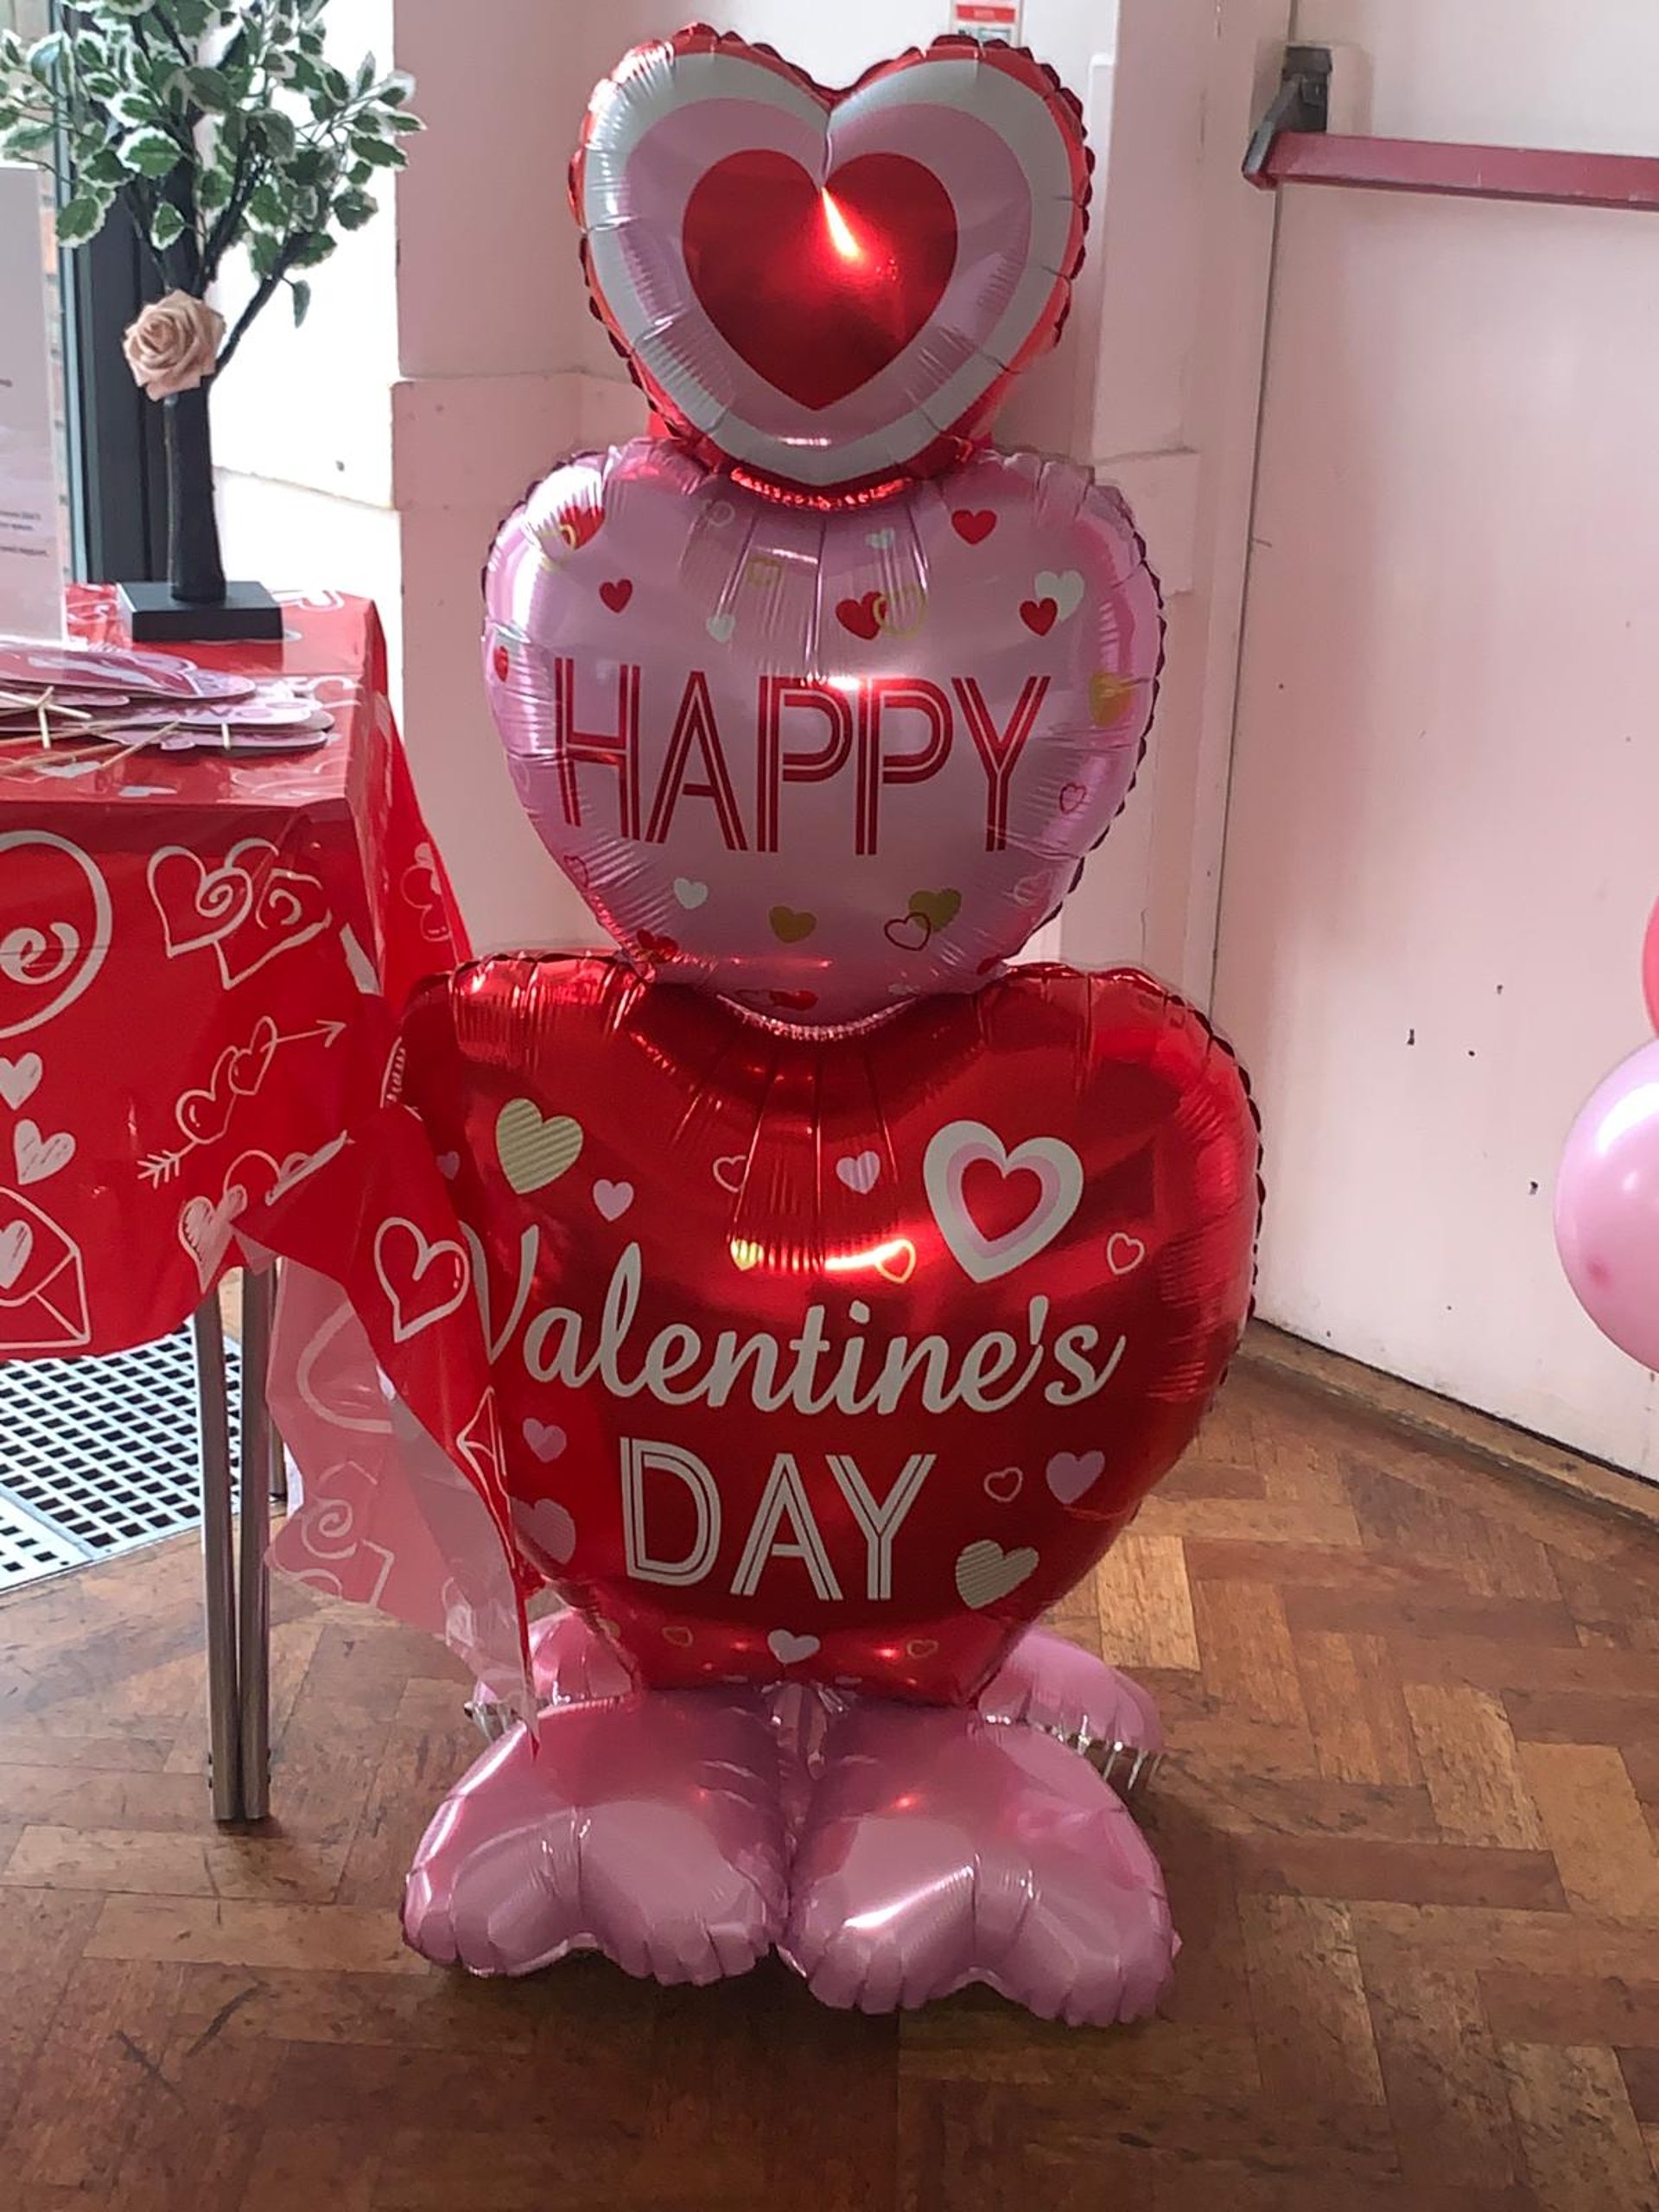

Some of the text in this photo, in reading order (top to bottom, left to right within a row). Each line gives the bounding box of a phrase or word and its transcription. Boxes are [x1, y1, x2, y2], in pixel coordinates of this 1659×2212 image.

[555, 658, 1050, 855] HAPPY
[458, 1220, 1126, 1415] Valentine's
[620, 1437, 937, 1601] DAY
